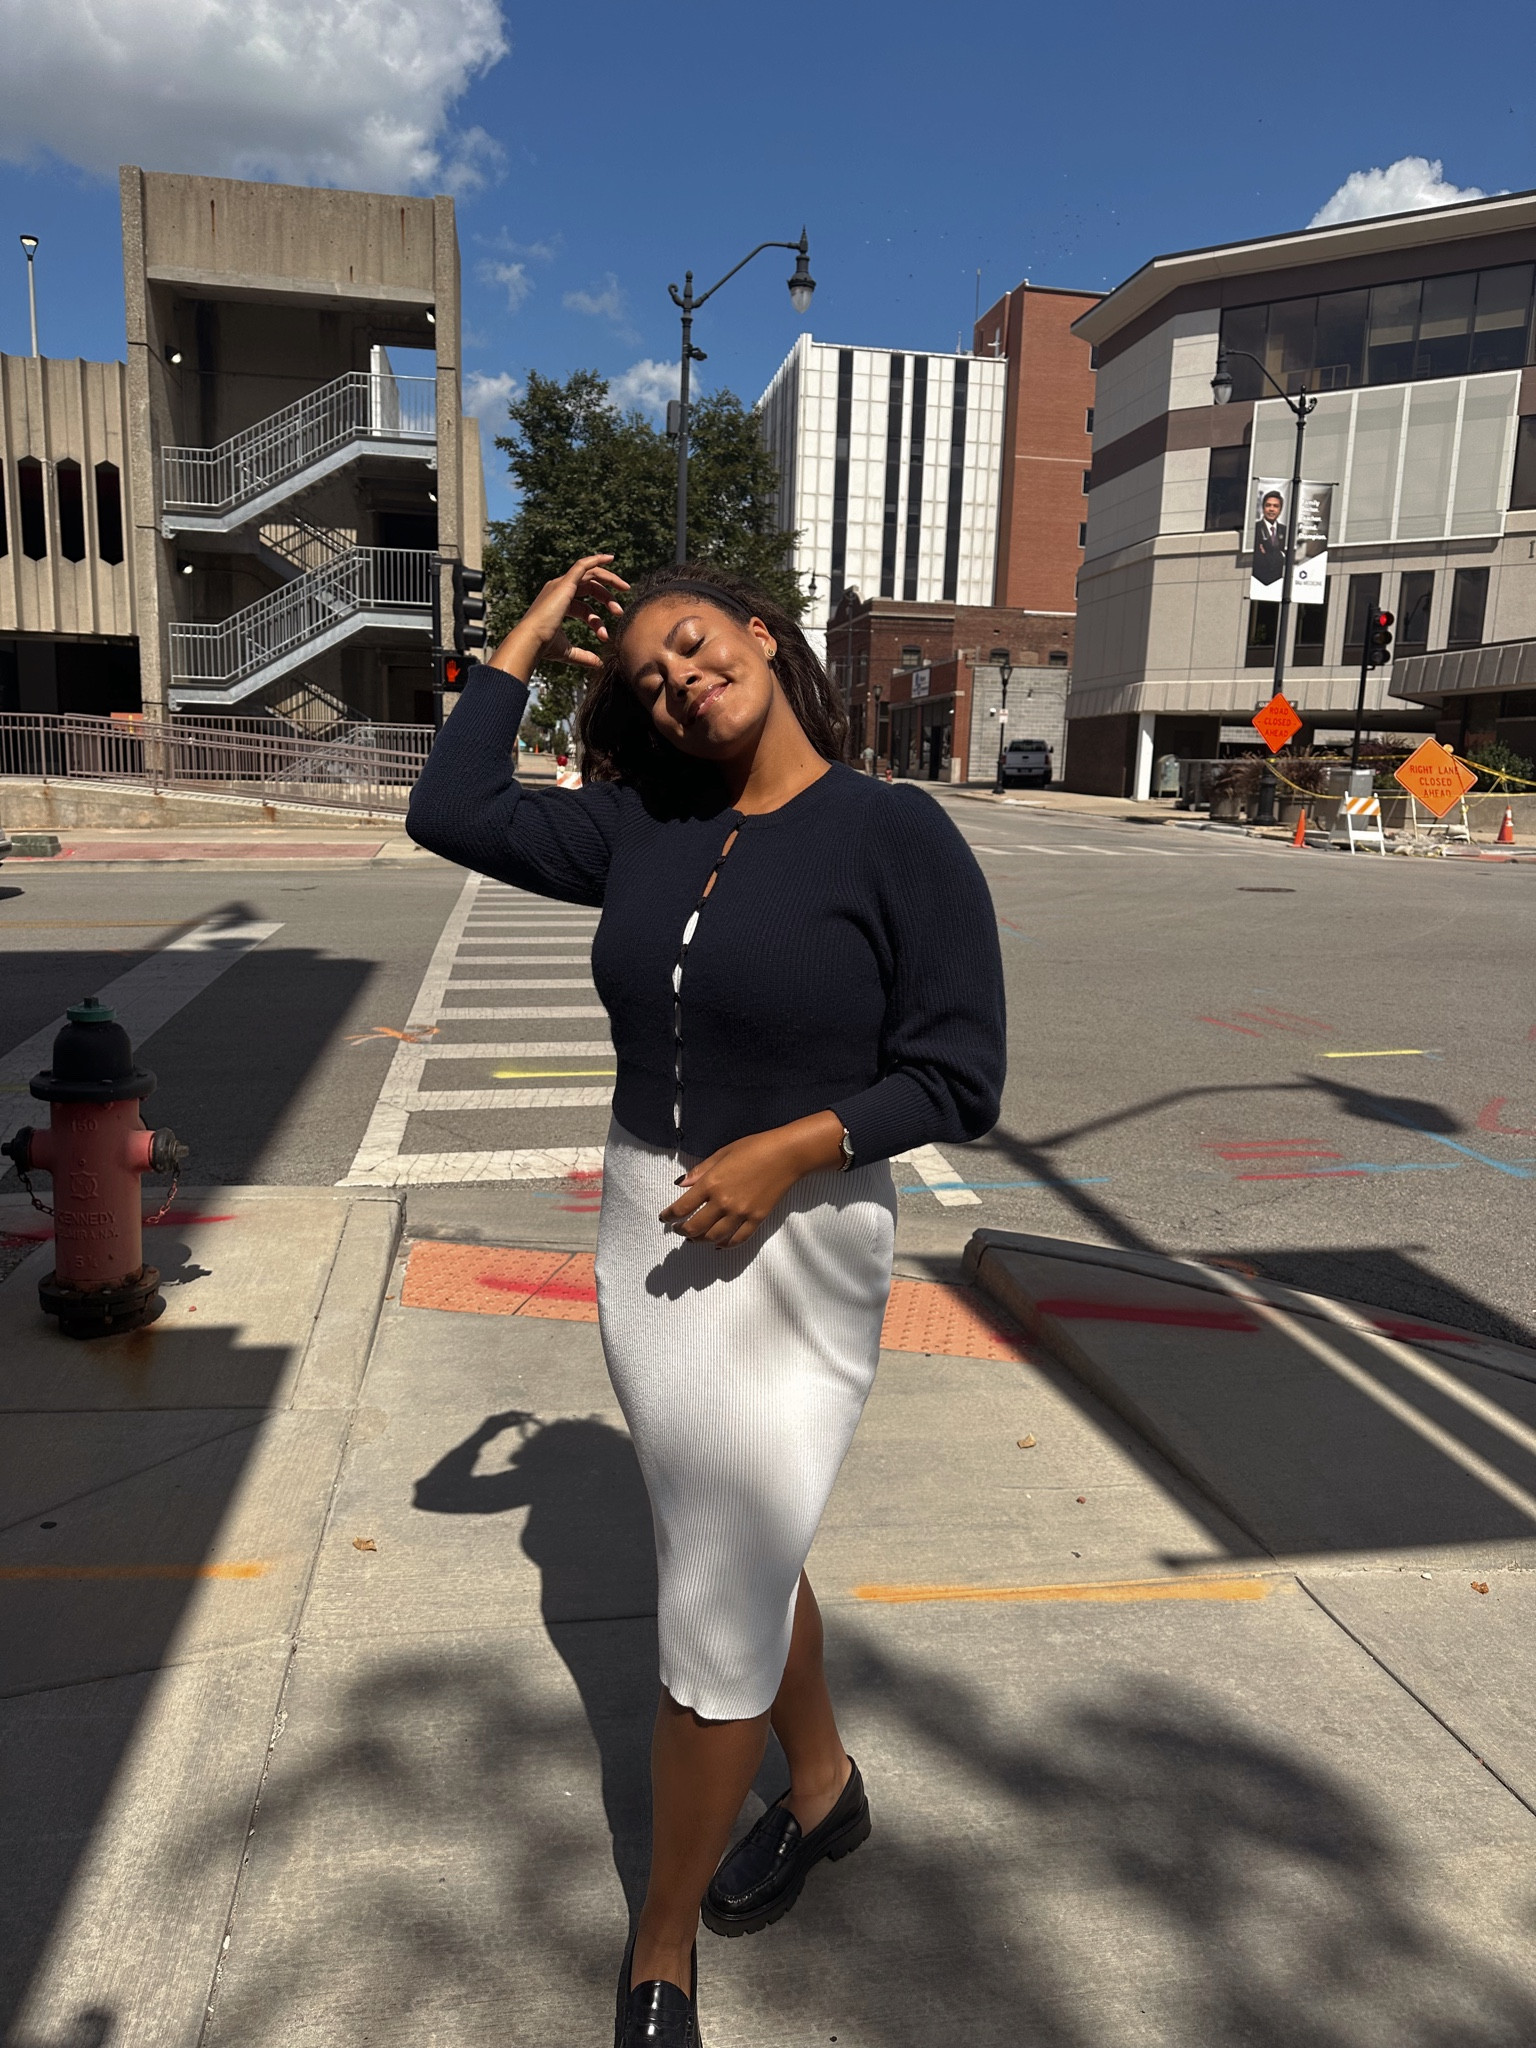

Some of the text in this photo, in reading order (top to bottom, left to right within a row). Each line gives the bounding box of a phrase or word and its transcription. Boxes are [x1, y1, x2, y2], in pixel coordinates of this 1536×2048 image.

[1270, 707, 1289, 716] ROAD
[1264, 717, 1291, 727] CLOSED
[1265, 729, 1289, 738] AHEAD
[1409, 765, 1459, 775] RIGHT LANE
[1419, 777, 1452, 787] CLOSED
[1423, 789, 1451, 798] AHEAD
[71, 1118, 99, 1132] 150
[56, 1210, 115, 1226] KENNEDY
